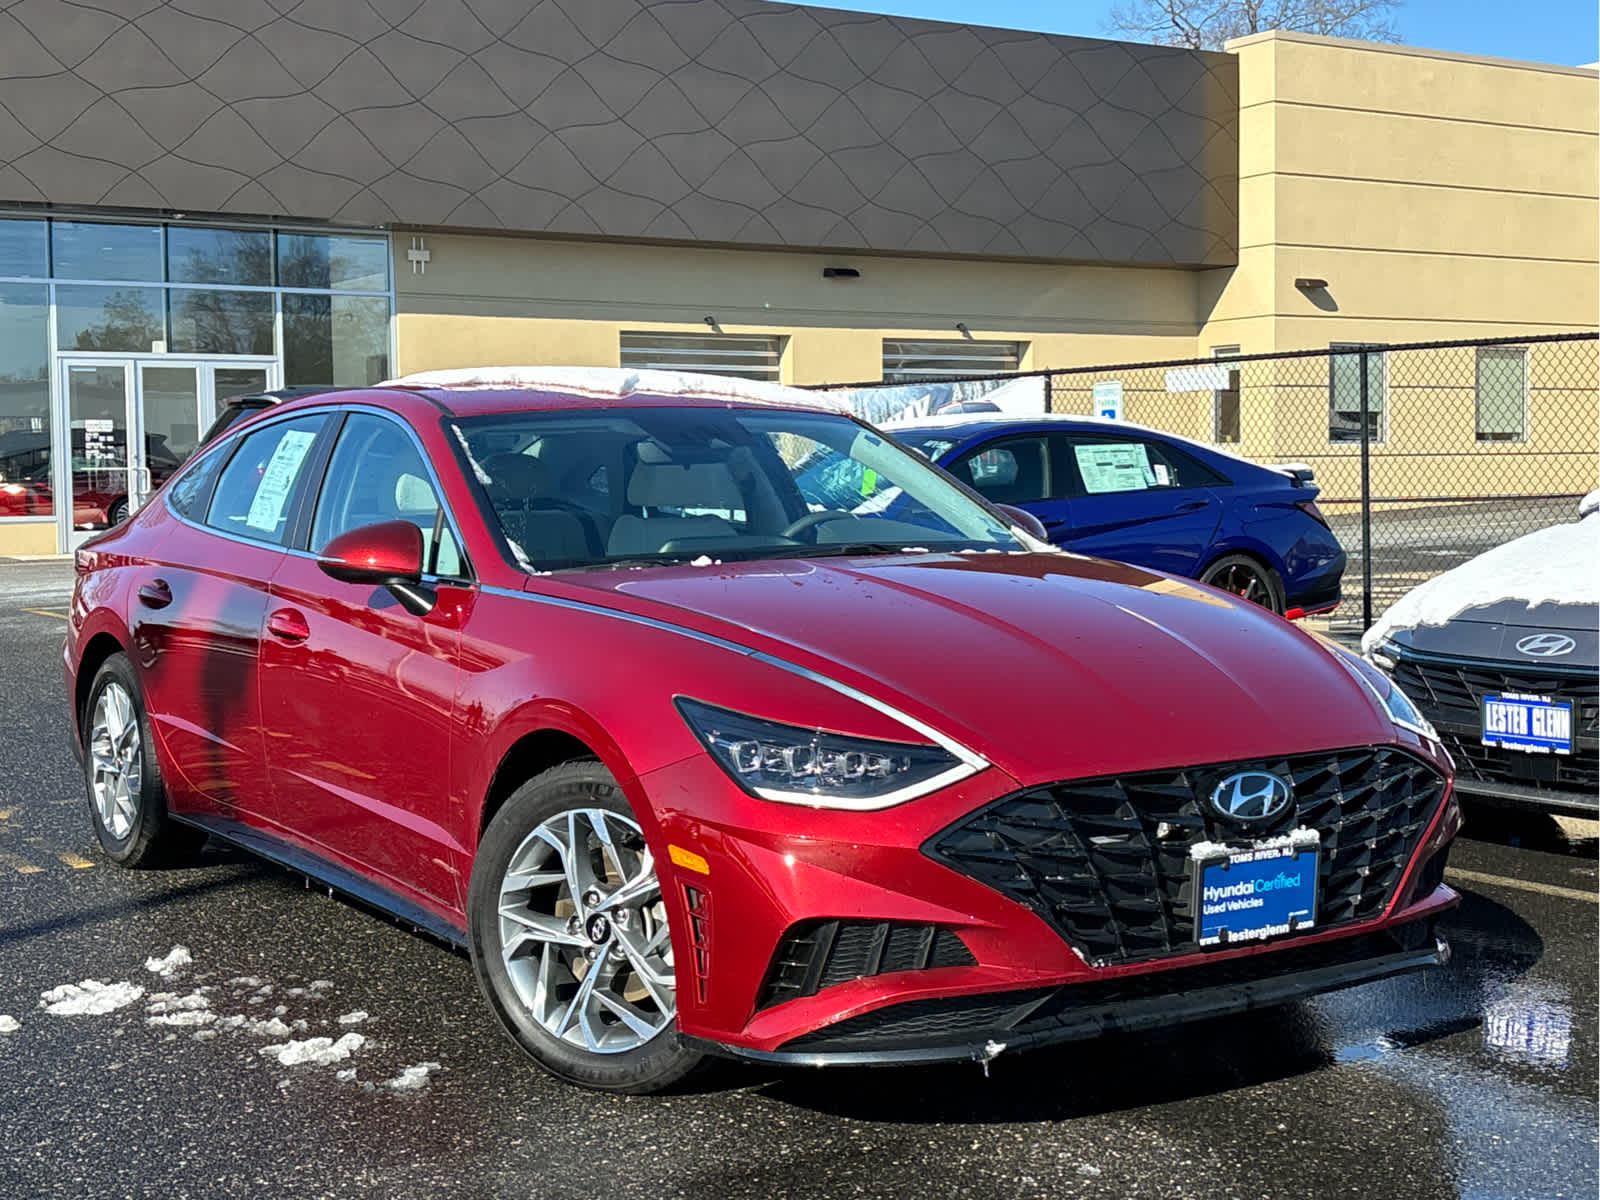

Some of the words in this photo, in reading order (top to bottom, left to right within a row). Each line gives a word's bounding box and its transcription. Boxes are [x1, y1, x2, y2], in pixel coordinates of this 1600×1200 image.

[1486, 703, 1528, 735] LESTER
[1532, 707, 1570, 739] GLENN
[1229, 852, 1253, 864] TOMS
[1282, 844, 1294, 857] NJ
[1203, 880, 1254, 902] Hyundai
[1255, 872, 1301, 892] Certified
[1203, 901, 1226, 915] Used
[1227, 898, 1264, 911] Vehicles
[1228, 924, 1290, 942] lesterglenn
